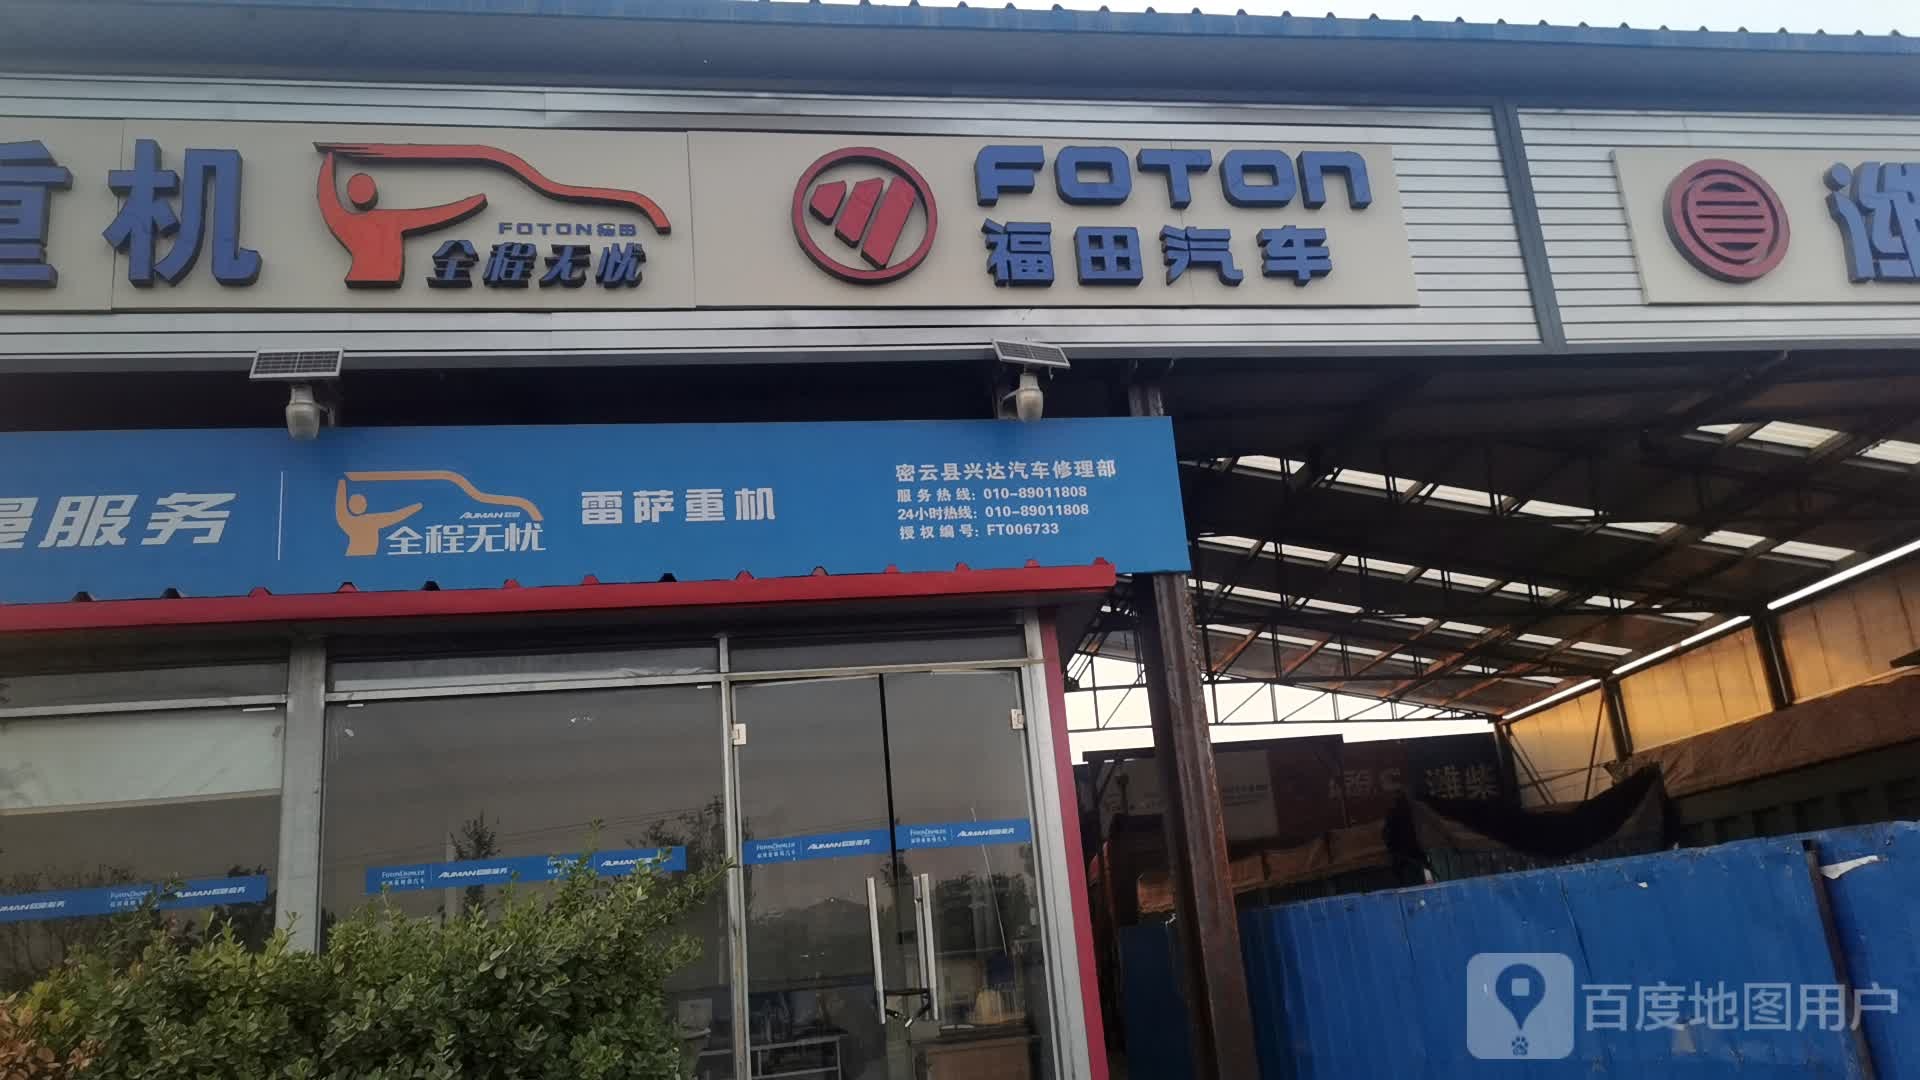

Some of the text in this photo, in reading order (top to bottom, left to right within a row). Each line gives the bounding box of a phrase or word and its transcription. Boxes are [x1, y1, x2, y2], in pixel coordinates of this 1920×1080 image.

[975, 145, 1371, 209] FOTON
[426, 239, 647, 289] 全程无忧
[981, 218, 1332, 288] 福田汽车
[896, 459, 1117, 482] 密云县兴达汽车修理部
[581, 487, 776, 525] 雷萨重机
[983, 486, 1087, 500] 010-89011808
[985, 504, 1089, 518] 010-89011808
[386, 523, 546, 556] 全程无忧
[986, 523, 1060, 536] FT006733
